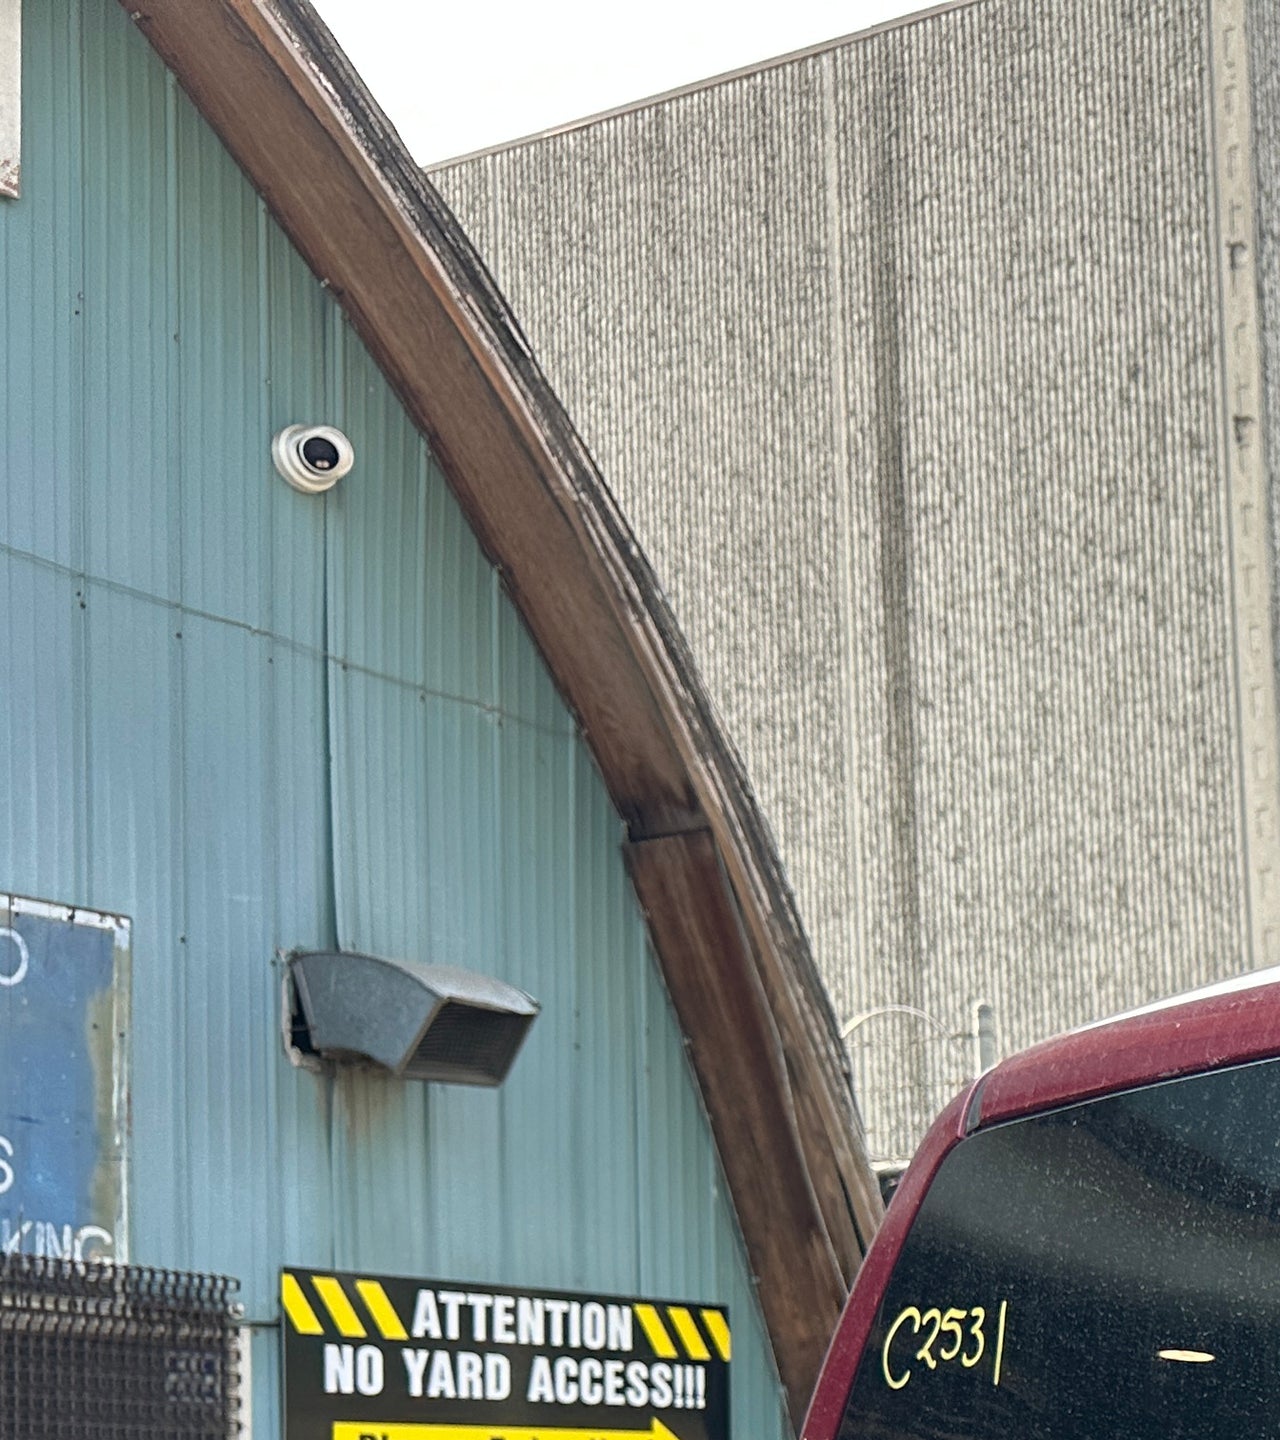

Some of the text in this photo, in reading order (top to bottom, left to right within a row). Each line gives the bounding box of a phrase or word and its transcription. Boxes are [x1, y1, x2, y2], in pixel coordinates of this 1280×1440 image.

[410, 1288, 634, 1352] ATTENTION
[882, 1299, 1008, 1390] C2531
[323, 1343, 707, 1410] NO YARD ACCESS!!!
